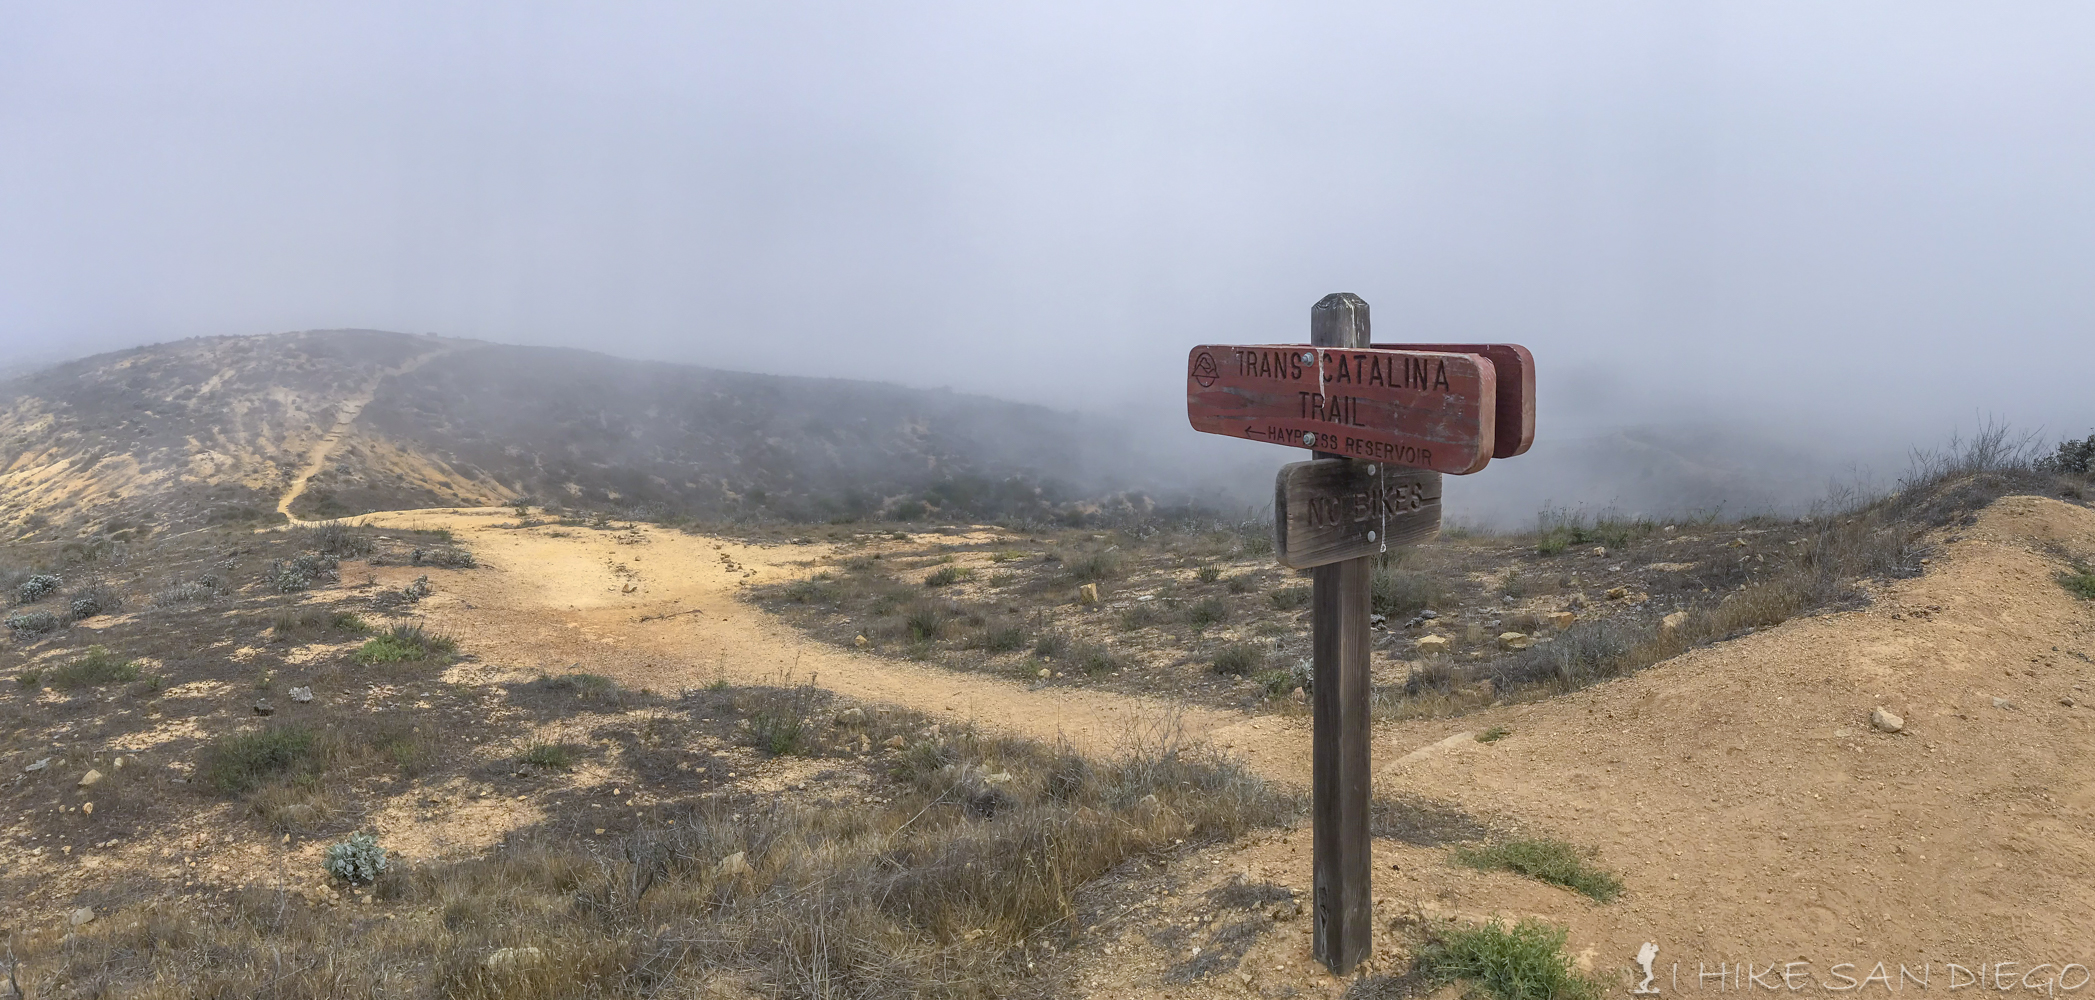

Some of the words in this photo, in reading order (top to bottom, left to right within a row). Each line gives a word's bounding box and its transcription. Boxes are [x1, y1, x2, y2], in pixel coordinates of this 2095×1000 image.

[1235, 351, 1302, 380] TRANS
[1322, 352, 1449, 392] CATALINA
[1298, 391, 1366, 427] TRAIL
[1345, 437, 1432, 466] RESERVOIR
[1307, 496, 1340, 528] NO
[1353, 482, 1423, 522] BIKES
